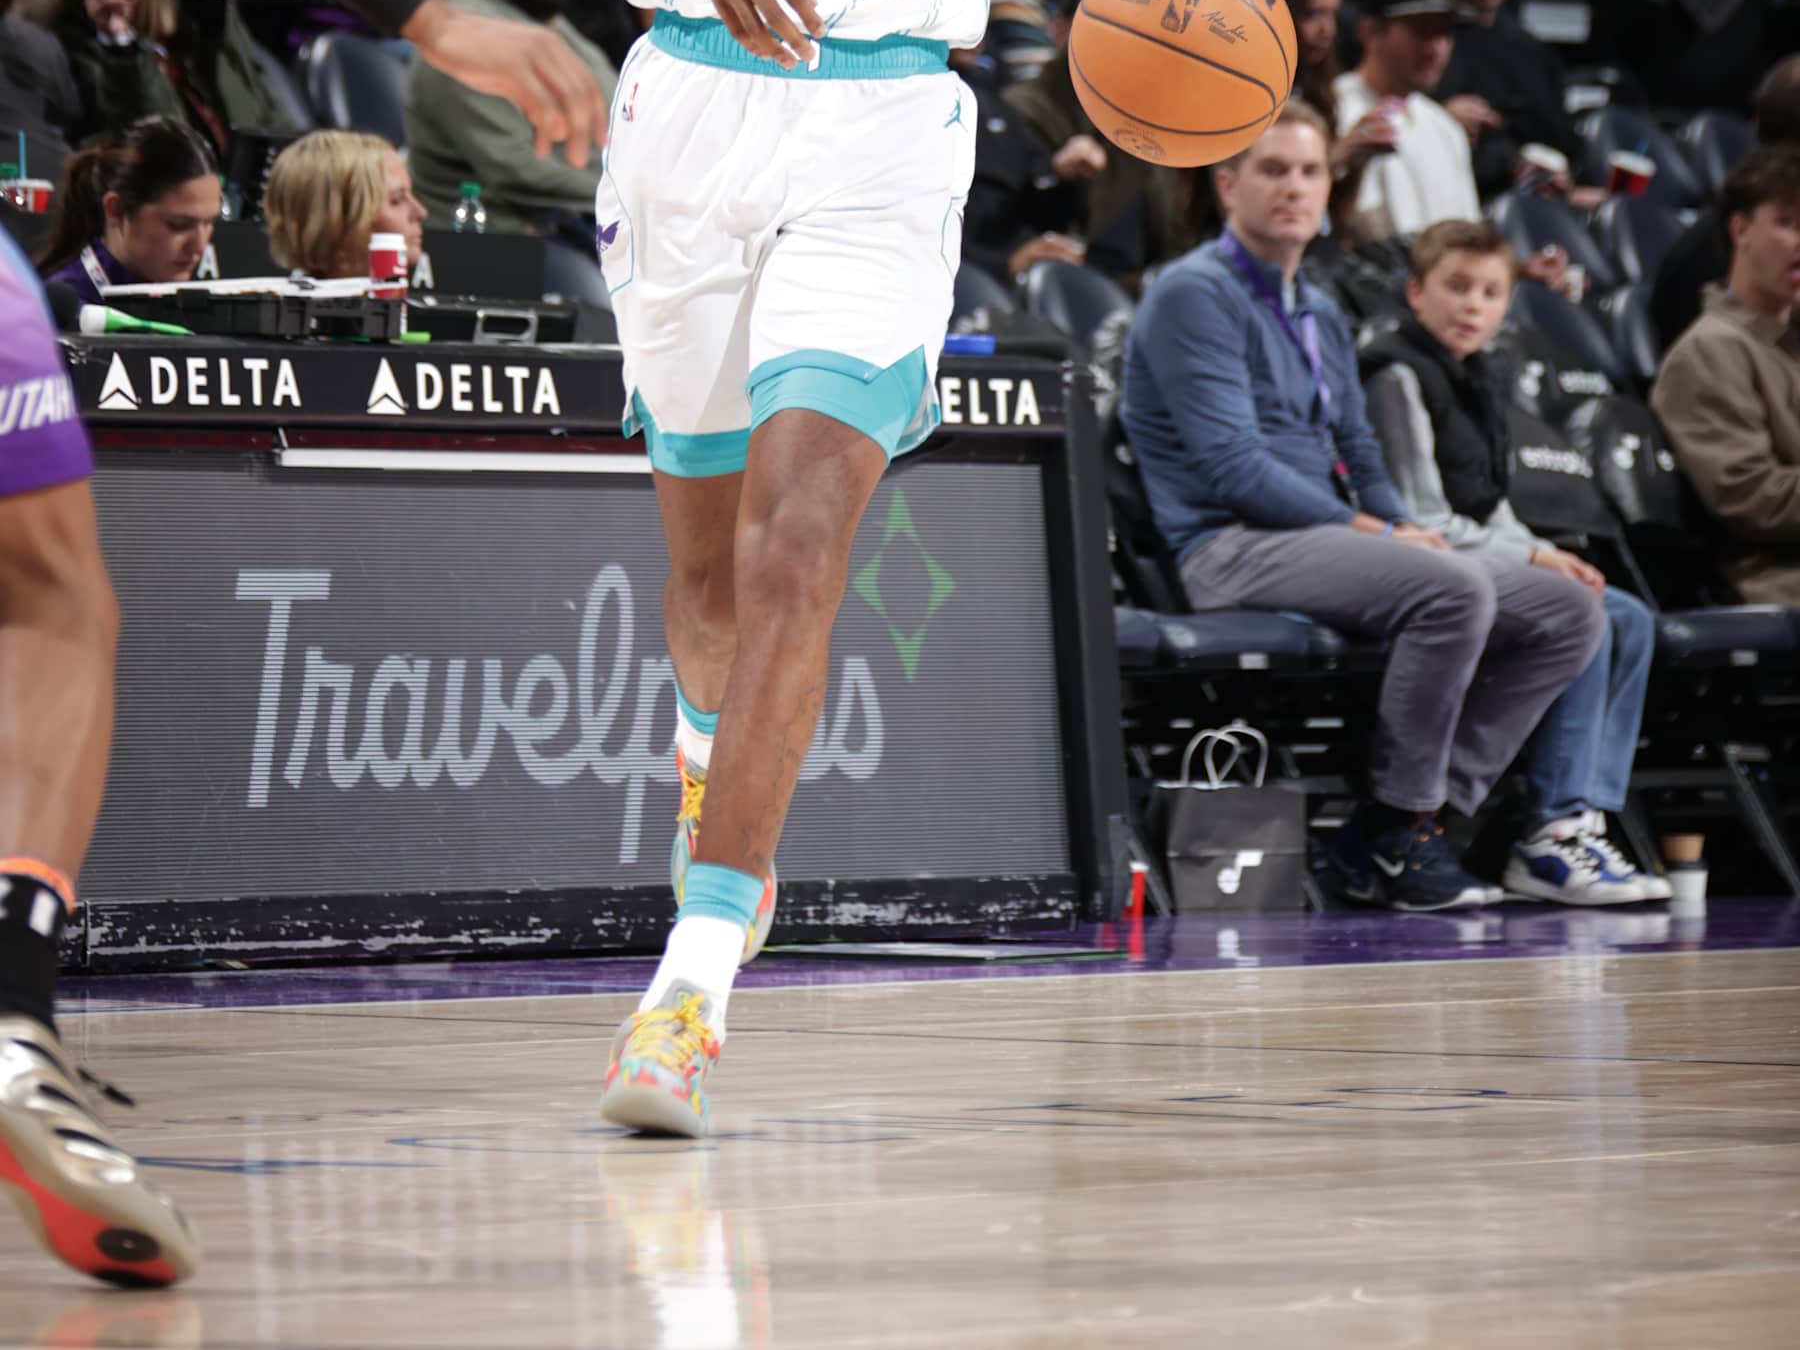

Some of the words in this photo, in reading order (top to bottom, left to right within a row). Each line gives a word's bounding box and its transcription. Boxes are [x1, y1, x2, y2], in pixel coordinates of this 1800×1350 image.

[149, 355, 302, 407] DELTA
[416, 362, 561, 416] DELTA
[939, 376, 1042, 426] ELTA
[234, 564, 885, 864] Travelps
